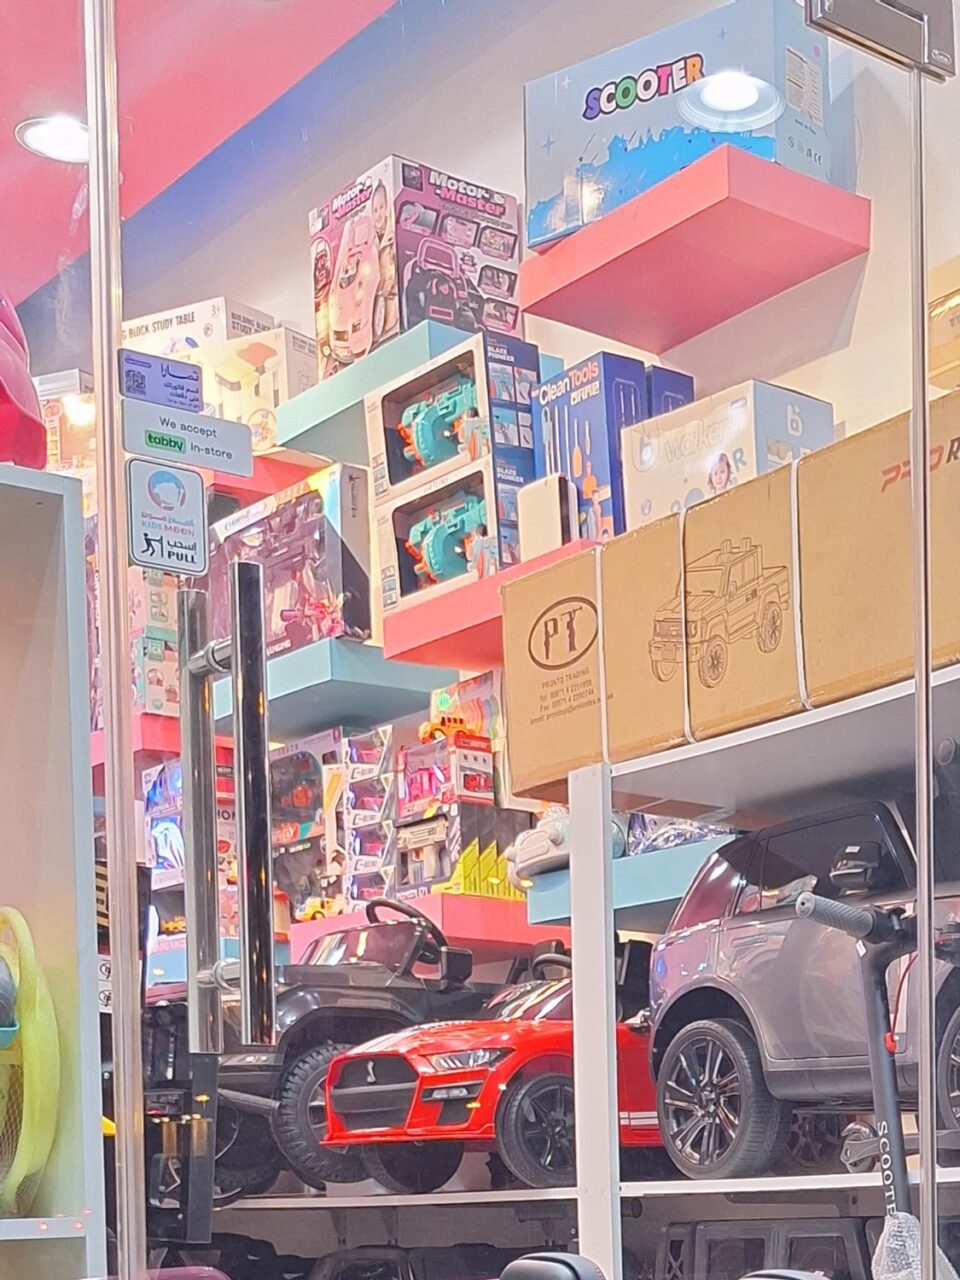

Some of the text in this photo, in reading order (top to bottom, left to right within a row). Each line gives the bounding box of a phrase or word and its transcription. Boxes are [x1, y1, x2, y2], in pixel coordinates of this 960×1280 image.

[582, 53, 705, 120] SCOOTER
[129, 325, 149, 339] BLOCK
[152, 319, 173, 334] STUDY
[175, 311, 196, 326] TABLE
[159, 416, 217, 438] We accept
[147, 433, 232, 459] tabby In-store
[141, 520, 195, 537] KIDS MOON
[168, 550, 197, 564] PULL
[543, 606, 583, 660] PT
[877, 1120, 897, 1218] SCOOTE
